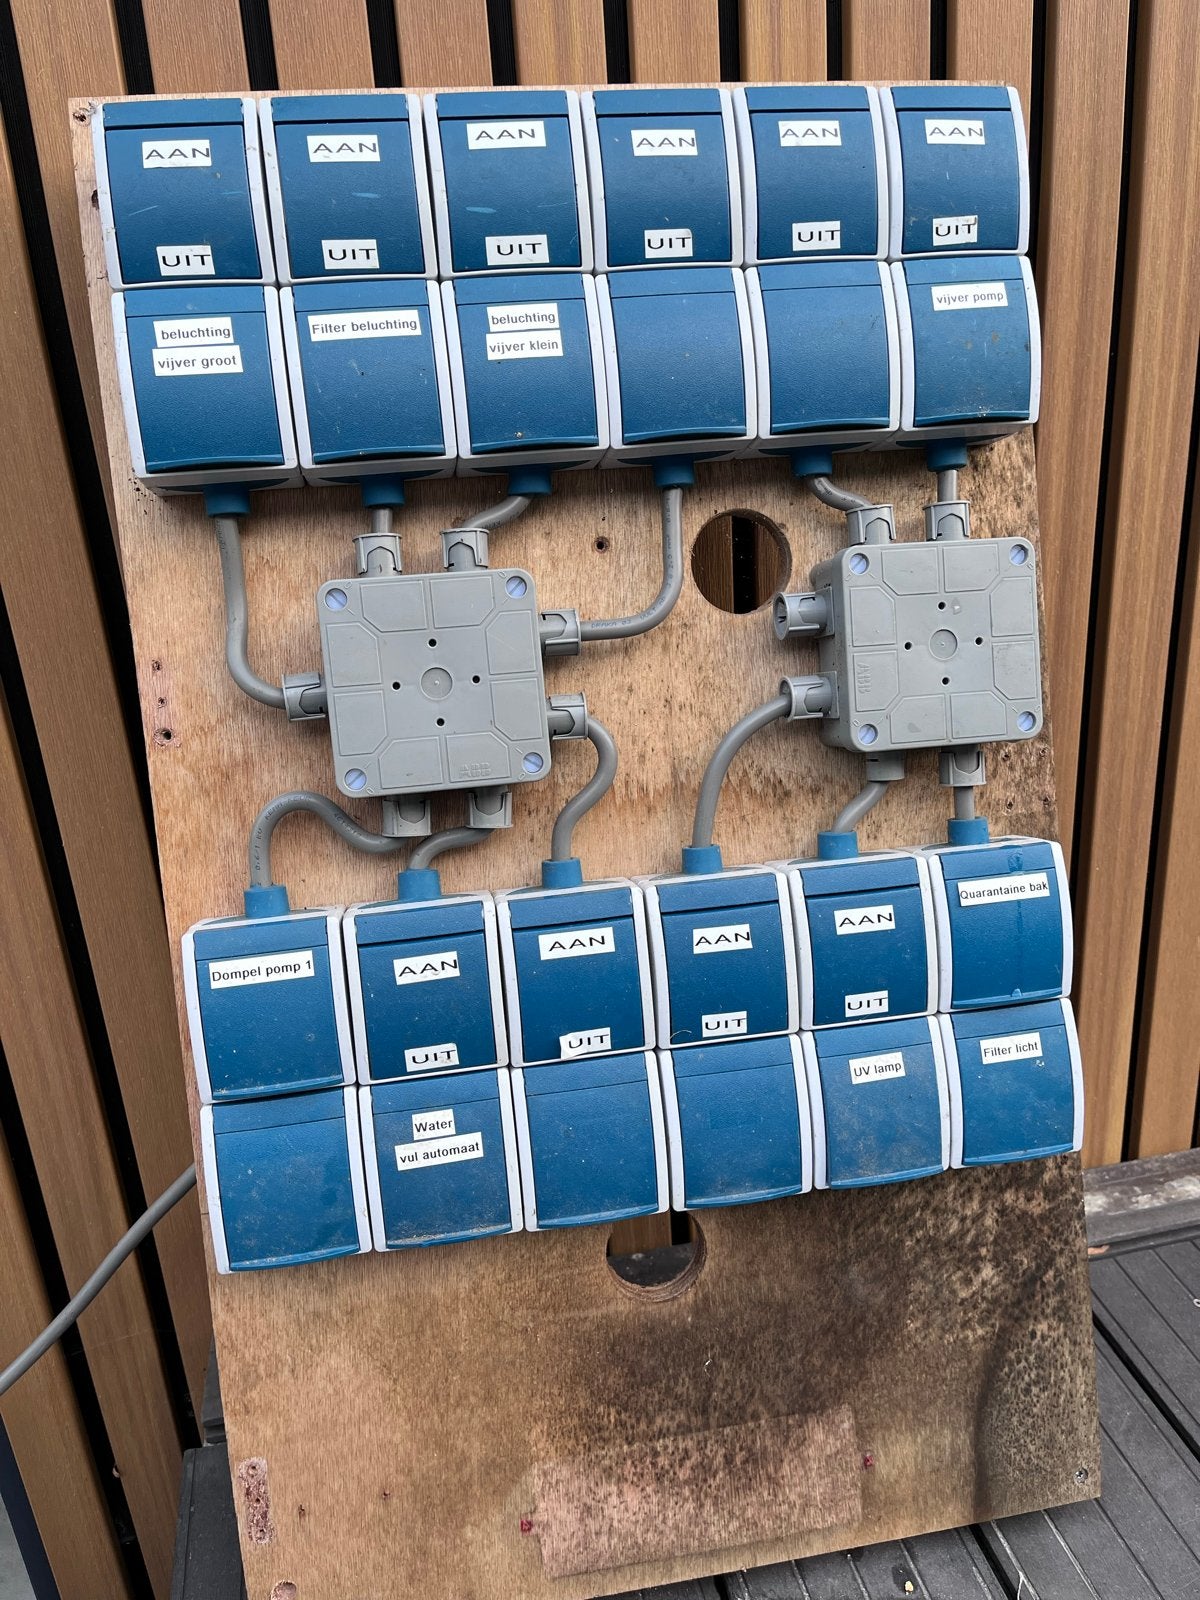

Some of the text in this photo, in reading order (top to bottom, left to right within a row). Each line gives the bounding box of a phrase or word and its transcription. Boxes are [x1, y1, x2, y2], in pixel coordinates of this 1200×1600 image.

[474, 127, 535, 141] AAN
[780, 126, 839, 138] AAN
[928, 125, 984, 138] AAN
[312, 141, 377, 154] AAN
[636, 136, 696, 149] AAN
[144, 146, 210, 160] AAN
[797, 229, 841, 243] UIT
[935, 222, 977, 237] UIT
[496, 242, 542, 256] UIT
[646, 235, 692, 250] UIT
[161, 253, 210, 268] UIT
[328, 247, 377, 261] UIT
[935, 289, 1004, 305] vijver pomp
[312, 318, 418, 335] Filter beluchting
[491, 310, 557, 327] beluchting
[161, 324, 231, 340] beluchting
[489, 338, 559, 354] vijver klein
[157, 354, 237, 370] vijver groot
[960, 881, 1049, 901] Quarantaine bak
[838, 911, 893, 928] AAN
[548, 935, 606, 952] AAN
[694, 930, 751, 946] AAN
[211, 959, 313, 983] Dompel pomp 1
[398, 959, 459, 978] AAN
[847, 996, 888, 1011] UIT
[704, 1017, 747, 1032] UIT
[568, 1033, 609, 1049] UIT
[983, 1040, 1039, 1058] Filter licht
[411, 1049, 457, 1065] UIT
[853, 1060, 902, 1078] UV lamp
[413, 1117, 454, 1133] Water
[399, 1141, 480, 1163] vul automaat
